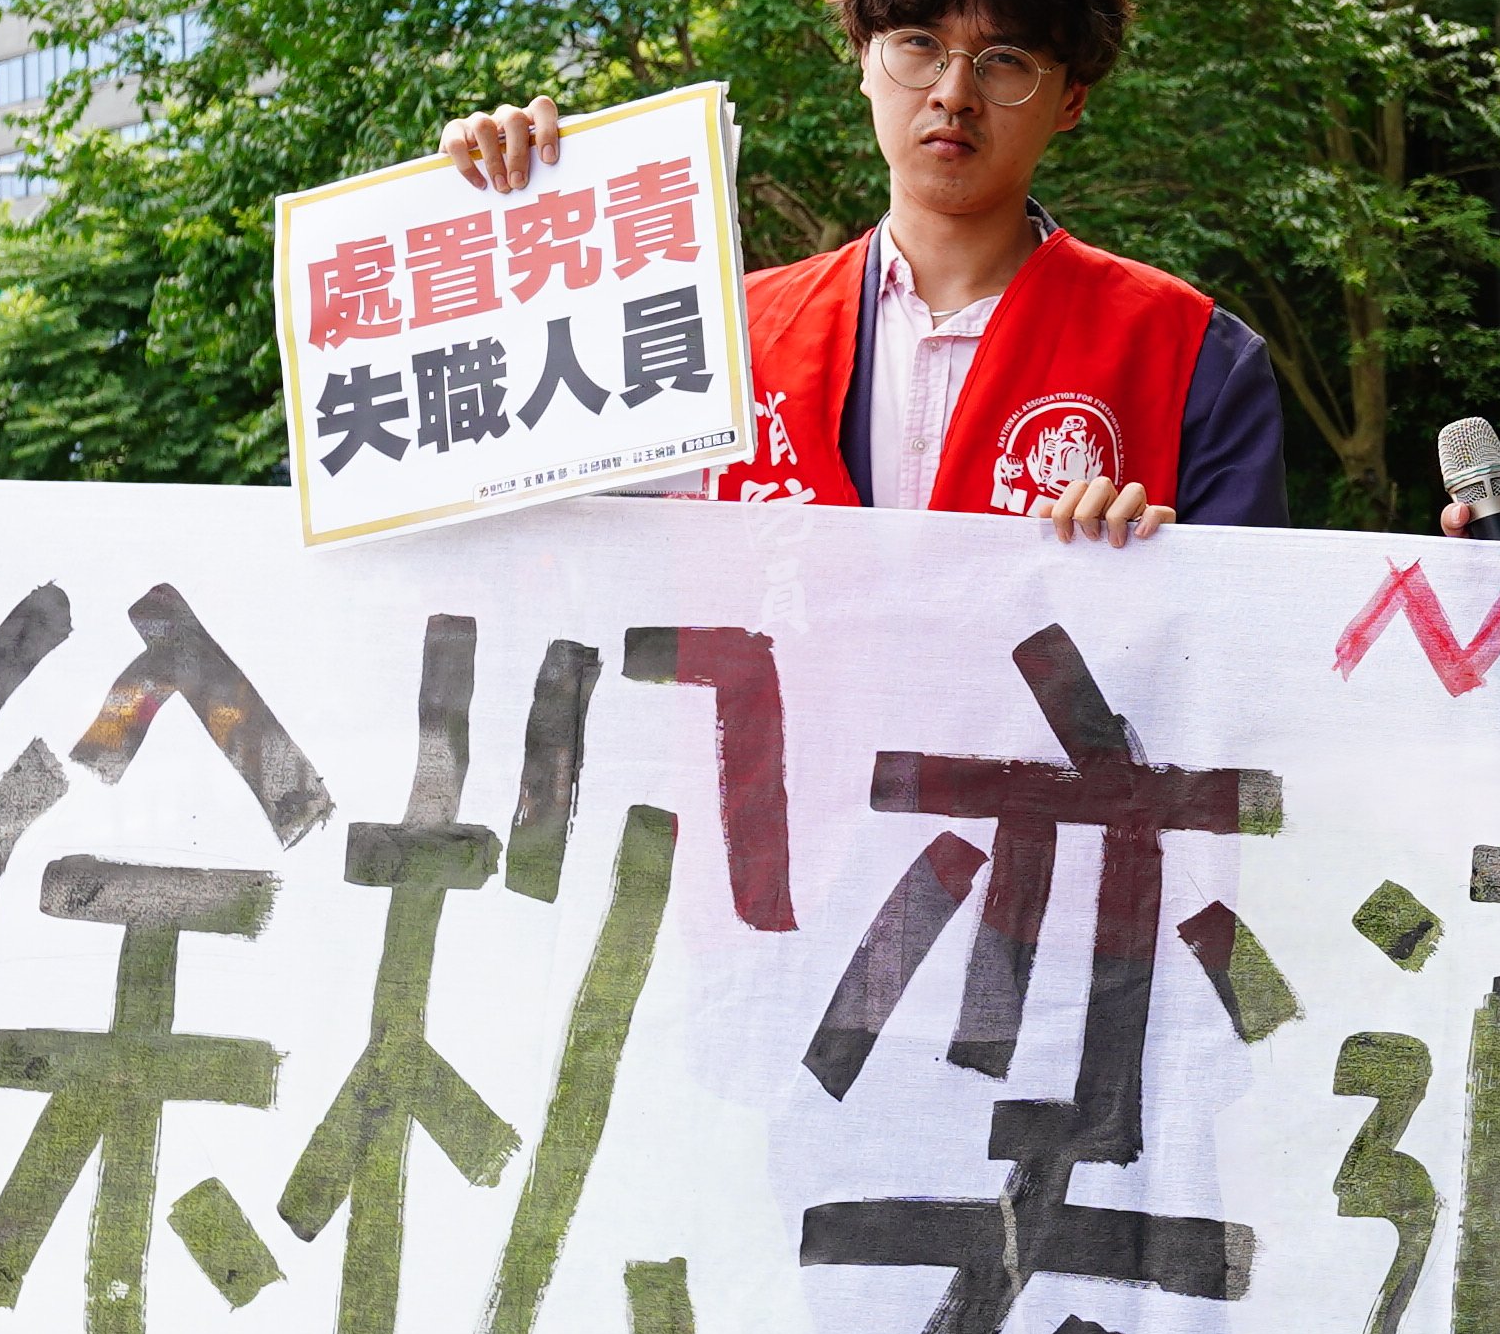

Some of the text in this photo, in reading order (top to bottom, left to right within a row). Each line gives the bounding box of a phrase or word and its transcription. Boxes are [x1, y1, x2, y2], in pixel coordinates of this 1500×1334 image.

[307, 156, 702, 352] 處置究責
[317, 285, 713, 478] 失職人員
[997, 409, 1023, 449] NATIONAL
[1022, 392, 1076, 413] ASSOCIATION
[1076, 393, 1094, 403] FOR
